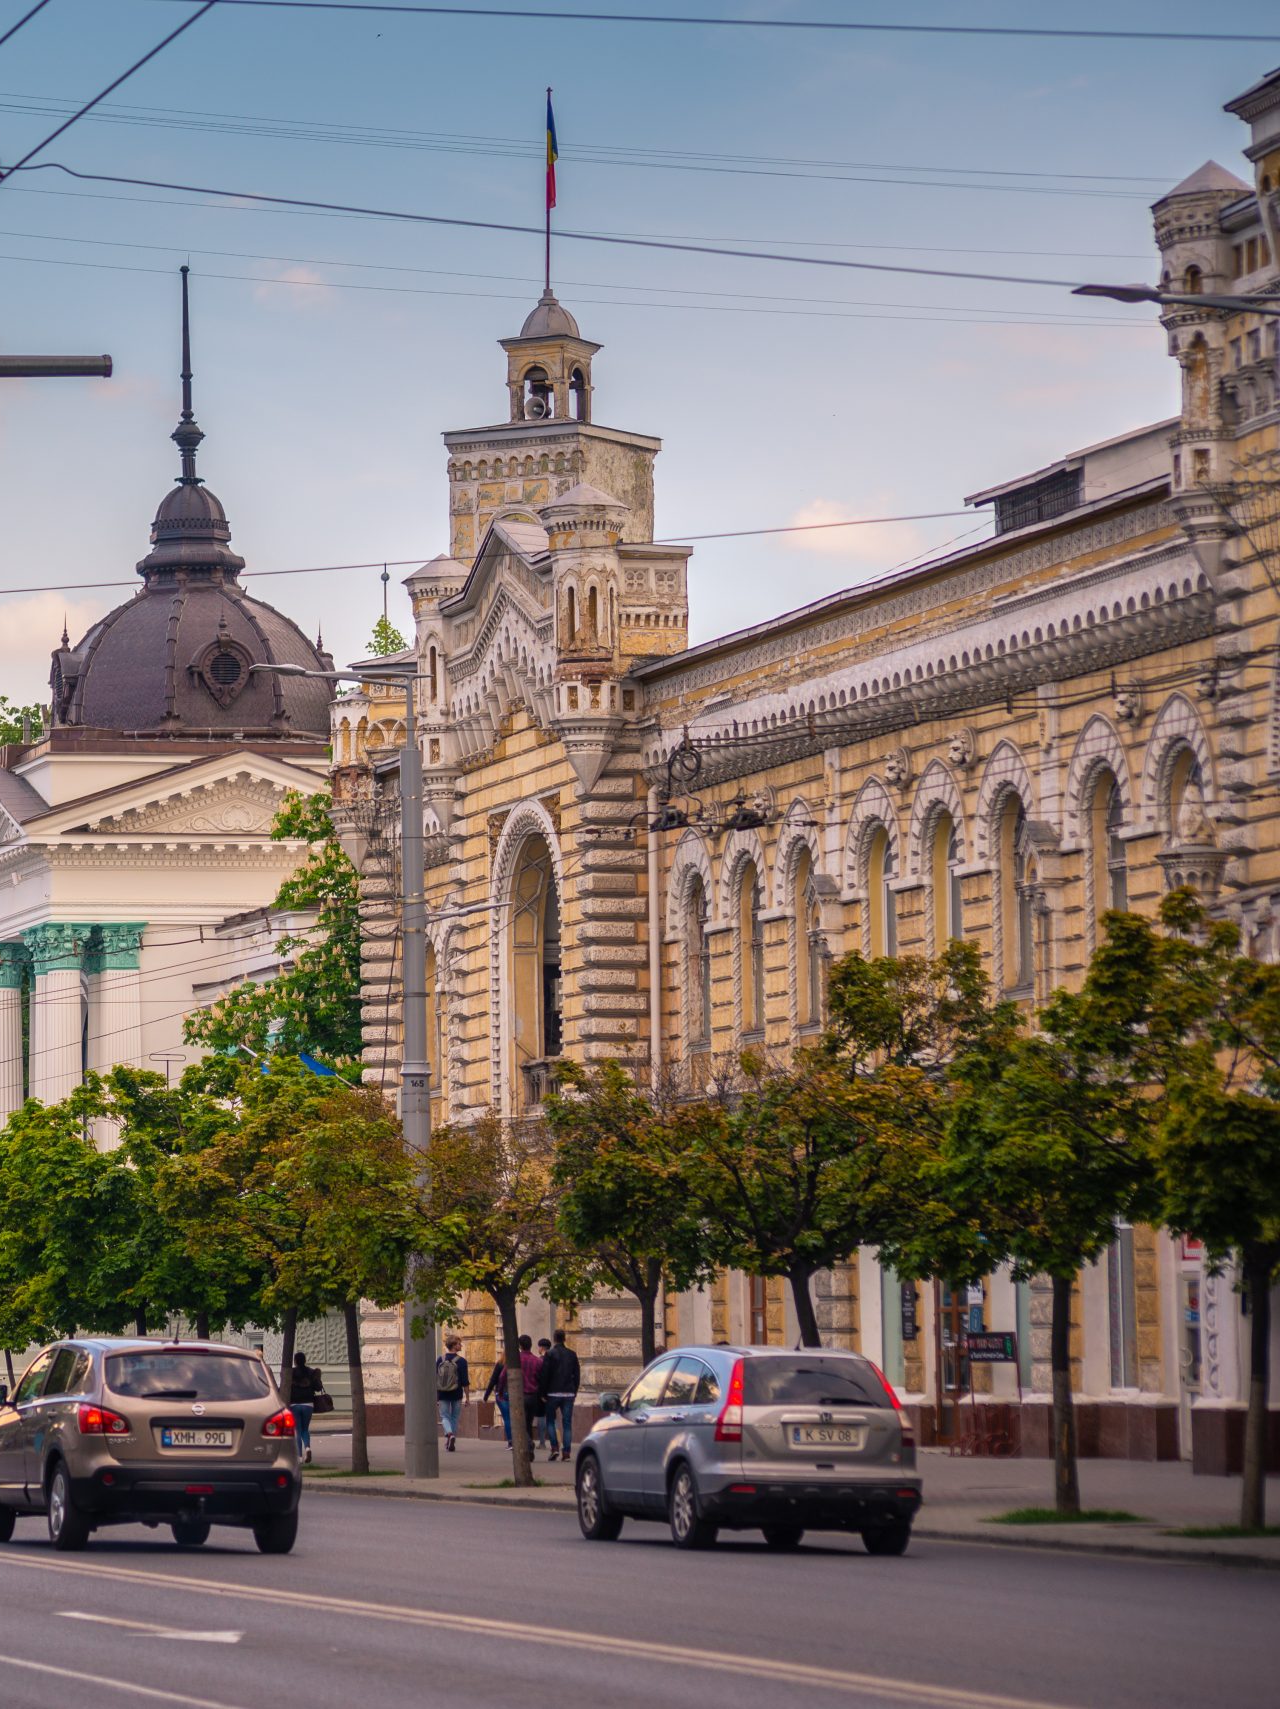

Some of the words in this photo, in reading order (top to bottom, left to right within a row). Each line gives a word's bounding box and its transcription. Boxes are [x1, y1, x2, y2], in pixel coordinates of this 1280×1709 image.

[173, 1431, 195, 1443] XMH
[204, 1432, 225, 1444] 990
[806, 1431, 814, 1441] K
[820, 1431, 834, 1441] SV
[838, 1431, 851, 1441] 08
